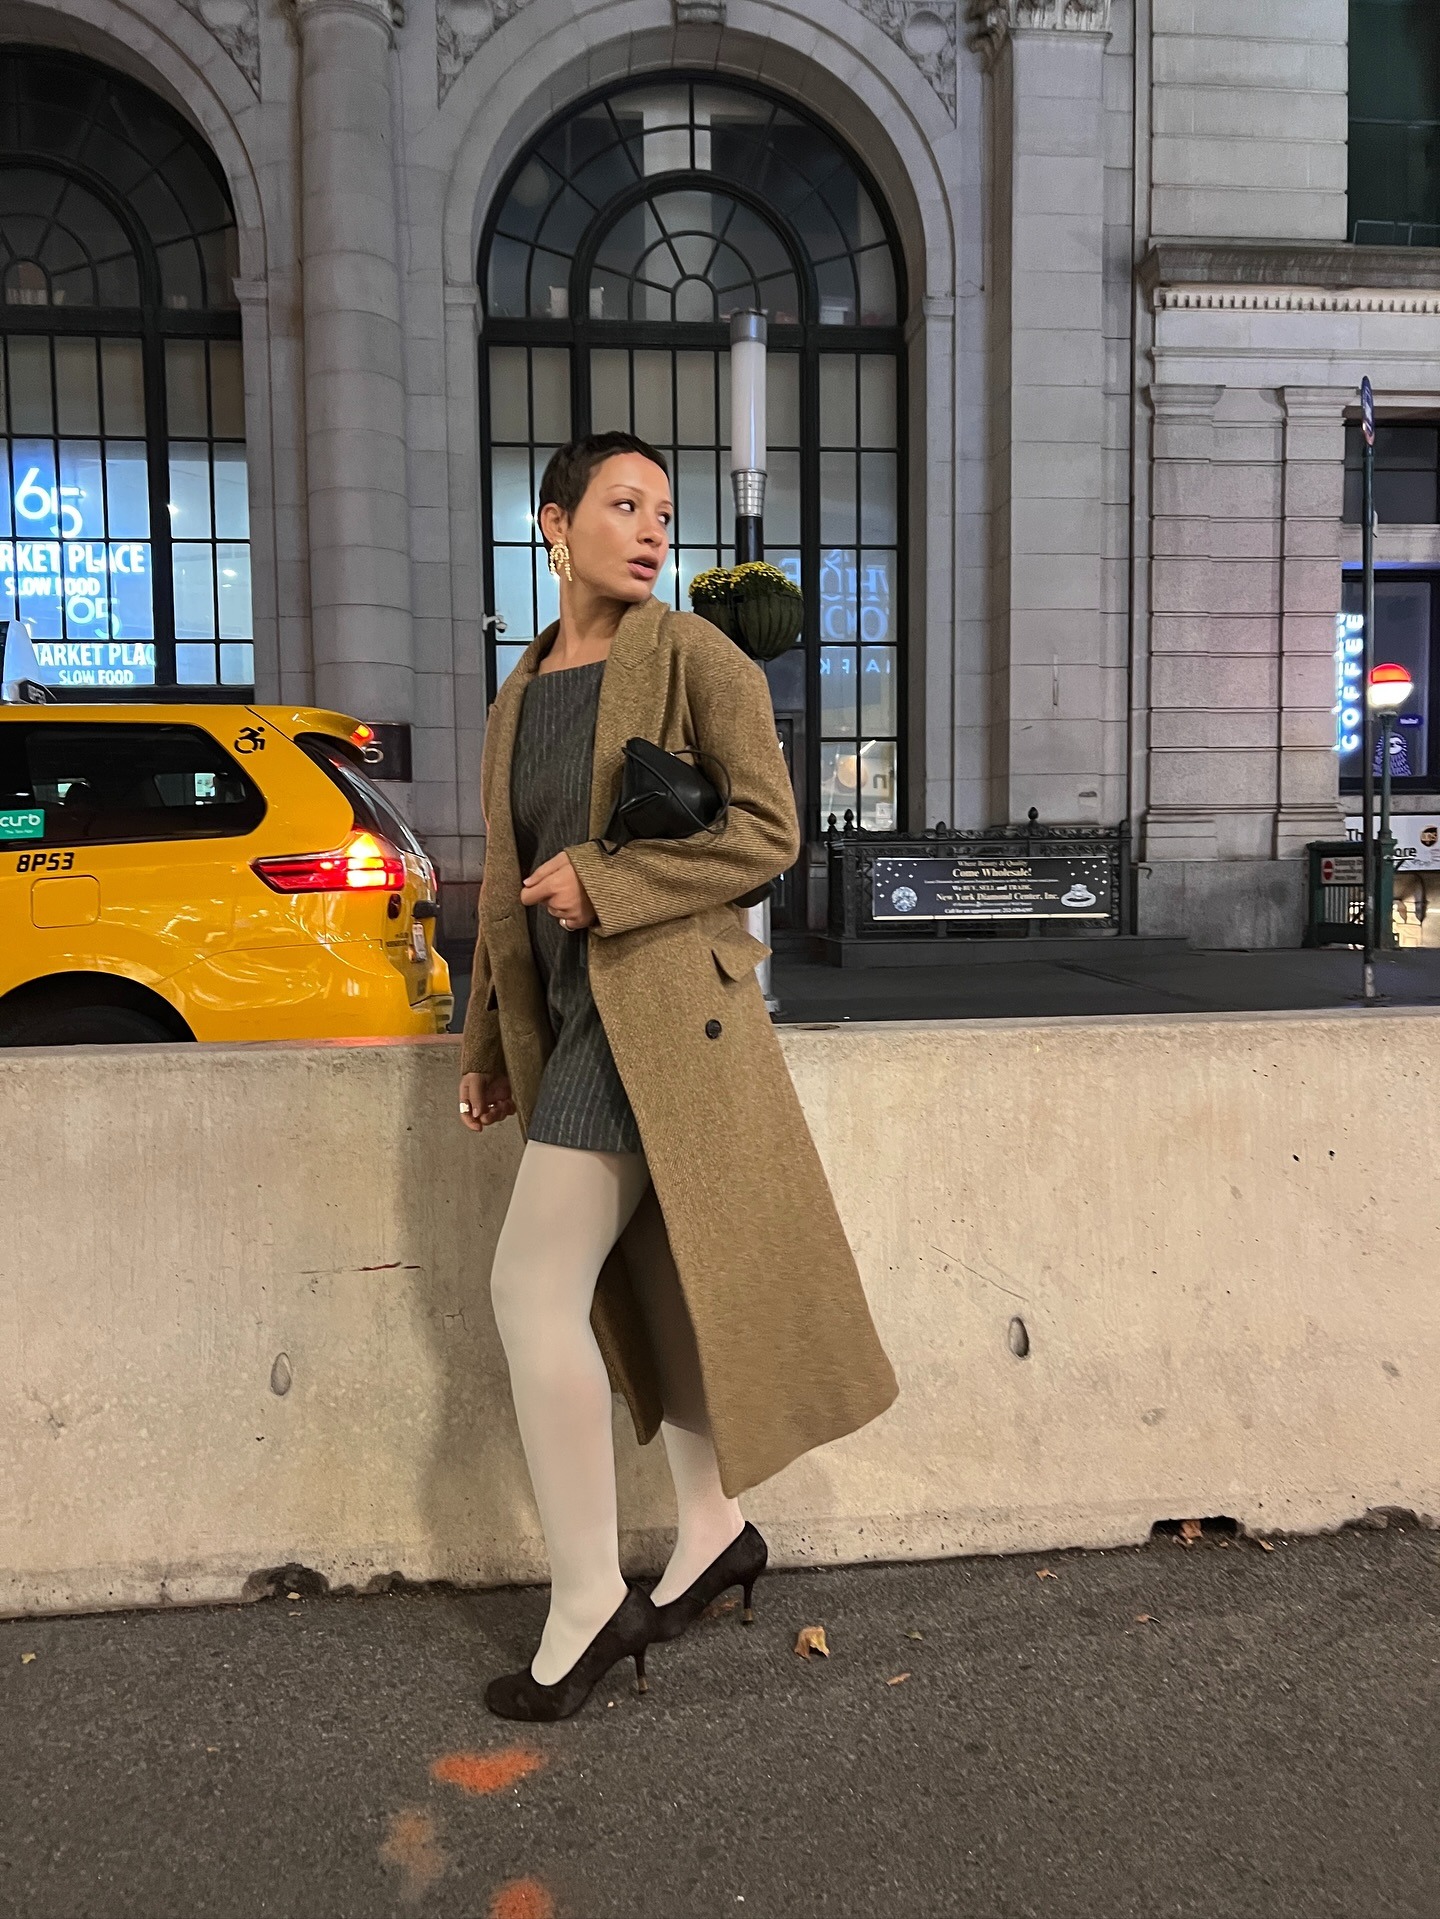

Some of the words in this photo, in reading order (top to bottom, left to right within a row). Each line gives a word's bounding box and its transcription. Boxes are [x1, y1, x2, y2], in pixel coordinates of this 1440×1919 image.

[15, 467, 83, 538] 65
[68, 544, 144, 573] PLACE
[58, 670, 94, 684] SLOW
[98, 670, 134, 685] FOOD
[1341, 614, 1363, 750] COFFEE
[0, 814, 41, 827] curb
[1346, 829, 1364, 841] Th
[1394, 847, 1417, 858] ore
[17, 852, 74, 872] 8P53
[952, 868, 980, 878] Come
[982, 867, 1032, 877] Wholesale!
[936, 893, 953, 901] New
[955, 892, 975, 900] York
[977, 892, 1012, 900] Diamond
